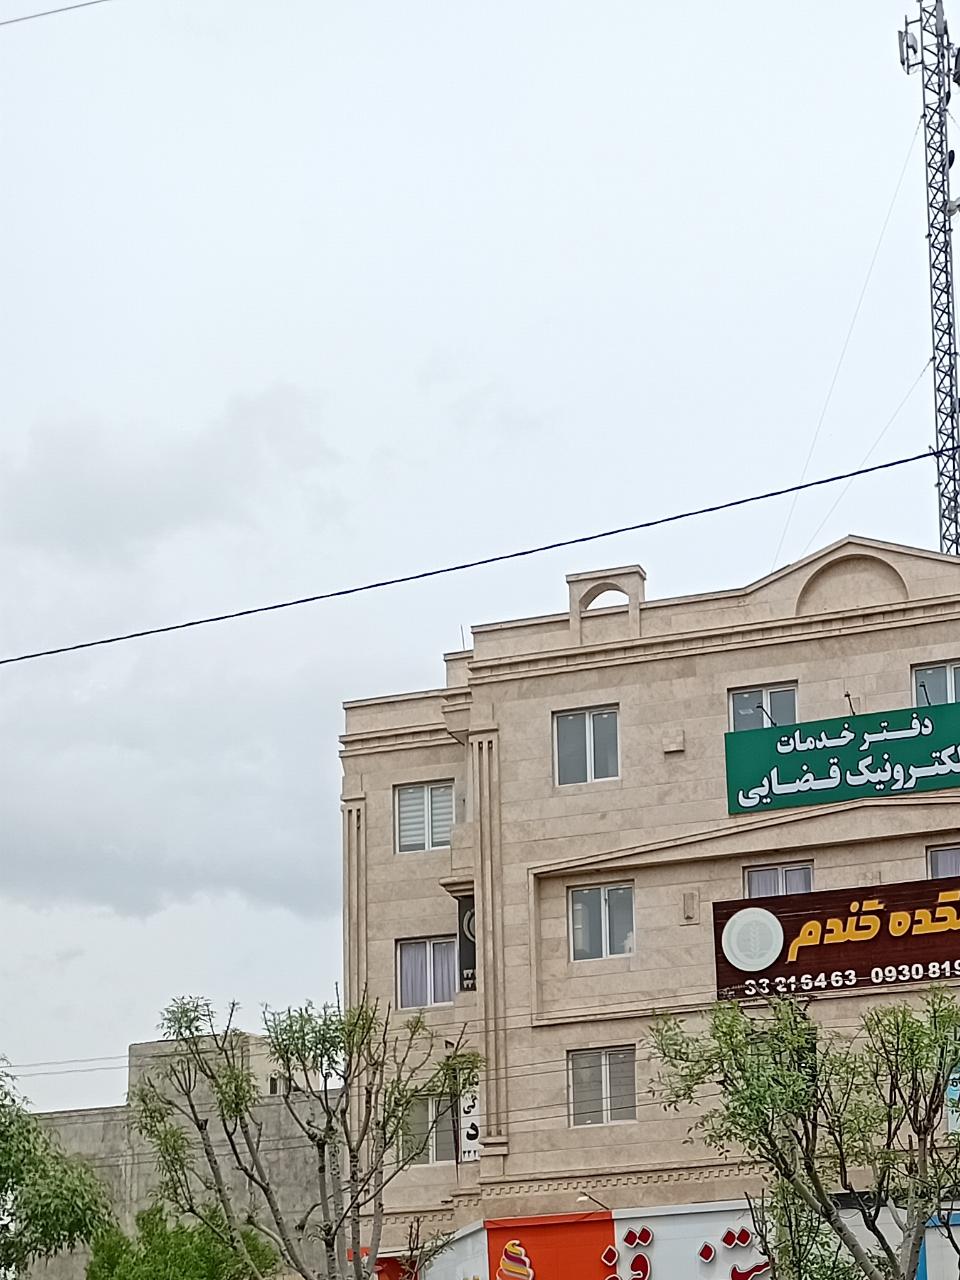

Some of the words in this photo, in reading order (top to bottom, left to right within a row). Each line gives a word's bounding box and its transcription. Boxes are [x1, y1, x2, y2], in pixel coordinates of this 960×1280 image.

[776, 722, 856, 754] خدمات
[859, 712, 934, 751] دفتر
[737, 756, 842, 808] قضایی
